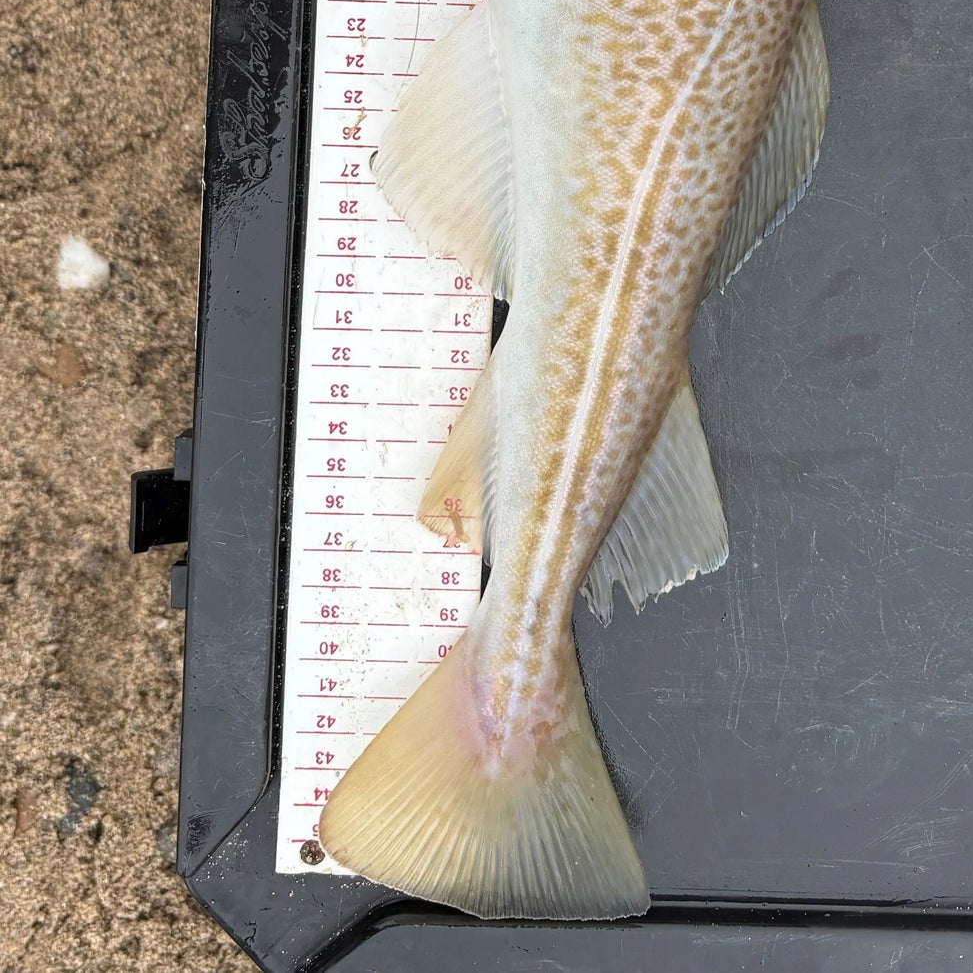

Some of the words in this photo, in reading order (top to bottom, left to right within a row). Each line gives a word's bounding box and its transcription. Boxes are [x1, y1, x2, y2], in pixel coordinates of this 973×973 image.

[347, 17, 366, 32] 23
[345, 54, 364, 68] 24
[343, 89, 363, 104] 25
[342, 125, 362, 141] 26
[340, 164, 360, 178] 27
[339, 200, 358, 214] 28
[337, 236, 356, 251] 29
[335, 273, 355, 288] 30
[453, 275, 473, 291] 30
[335, 310, 352, 324] 31
[454, 312, 471, 327] 31
[332, 346, 350, 361] 32
[450, 349, 469, 364] 32
[330, 384, 349, 398] 33
[449, 386, 469, 401] 33
[328, 421, 346, 435] 34
[326, 457, 345, 472] 35
[325, 495, 344, 509] 36
[444, 498, 463, 512] 36
[324, 532, 342, 546] 37
[322, 568, 340, 583] 38
[441, 571, 459, 585] 38
[320, 605, 340, 619] 39
[439, 608, 457, 622] 39
[319, 642, 339, 655] 40
[319, 678, 338, 692] 41
[316, 714, 336, 729] 42
[315, 751, 335, 765] 43
